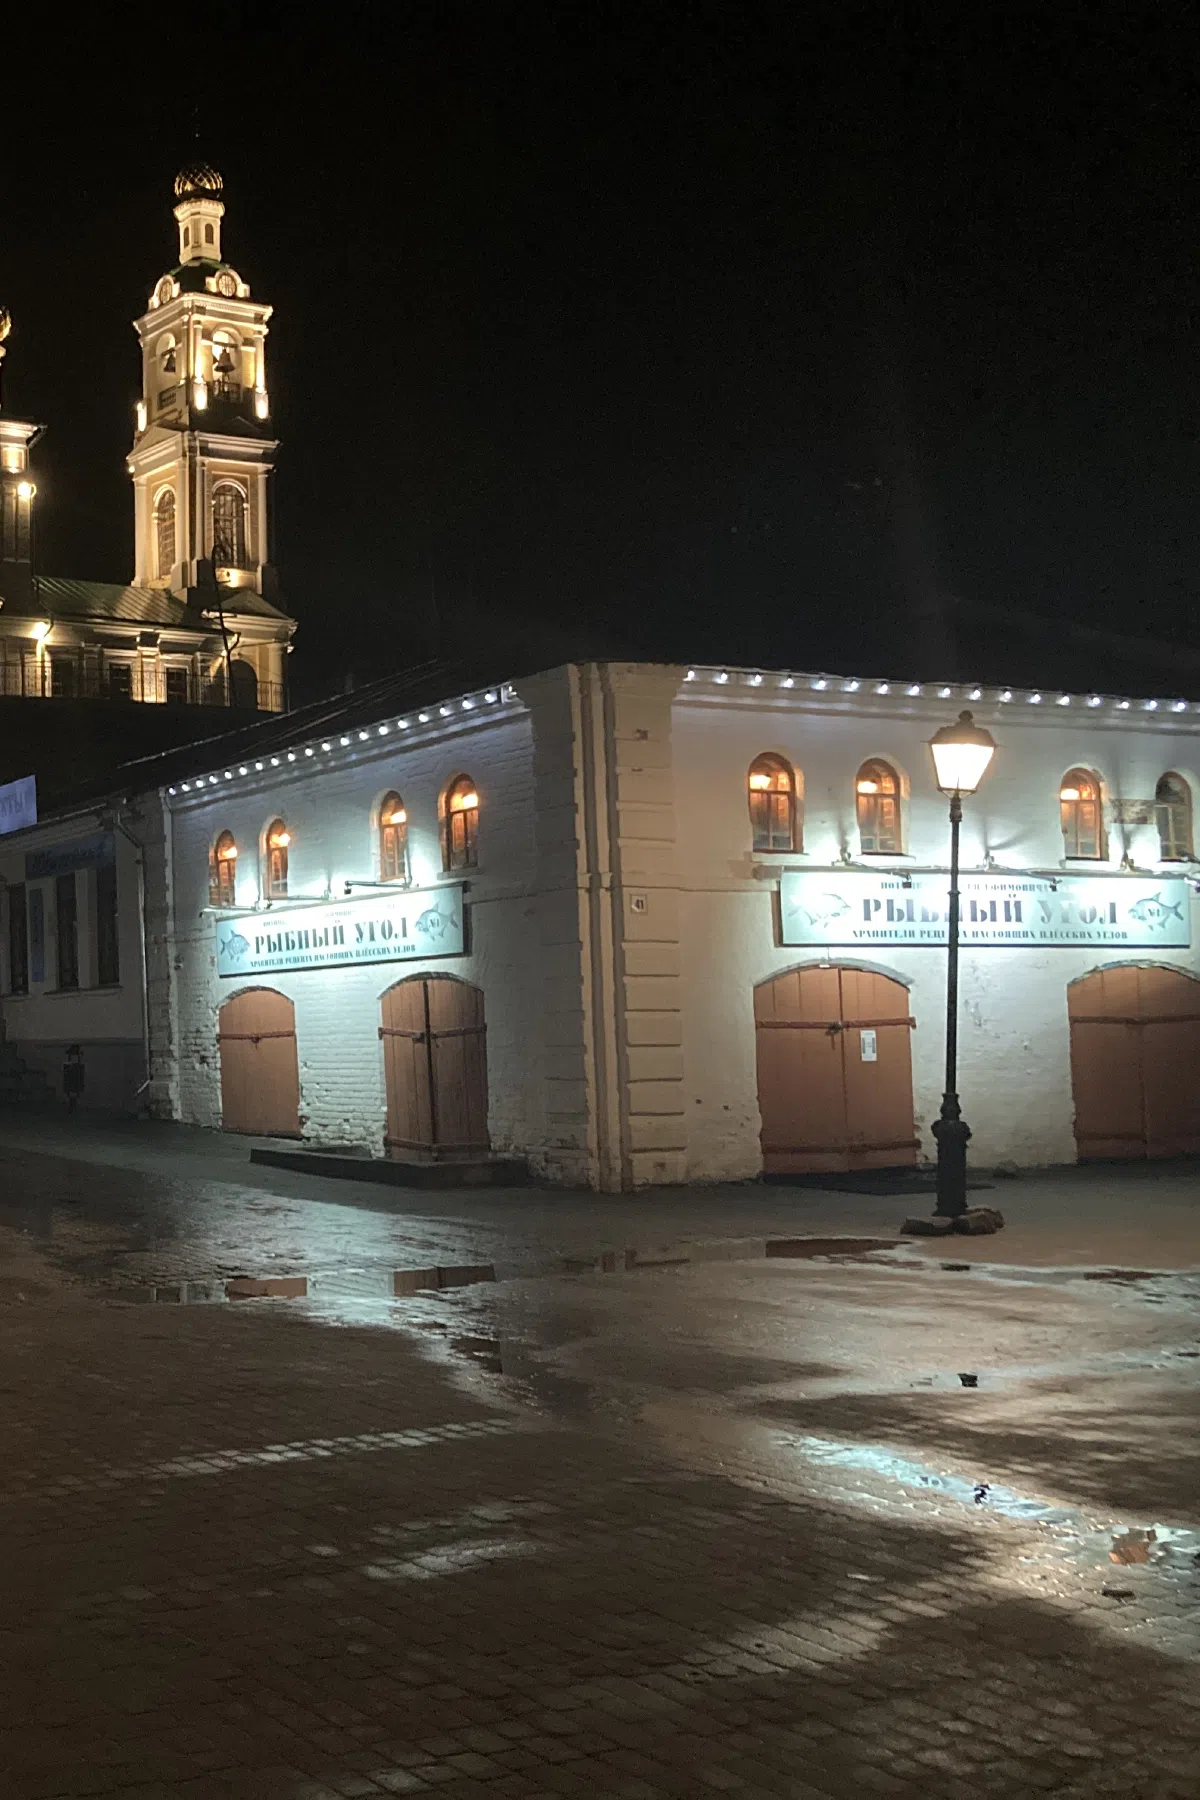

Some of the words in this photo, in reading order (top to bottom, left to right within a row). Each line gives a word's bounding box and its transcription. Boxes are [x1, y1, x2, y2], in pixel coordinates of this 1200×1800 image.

[1036, 899, 1119, 925] УГОЛ
[254, 919, 345, 955] РЫБНЫЙ
[354, 916, 409, 944] УГОЛ
[971, 930, 1036, 940] НАСТОЯЩИХ
